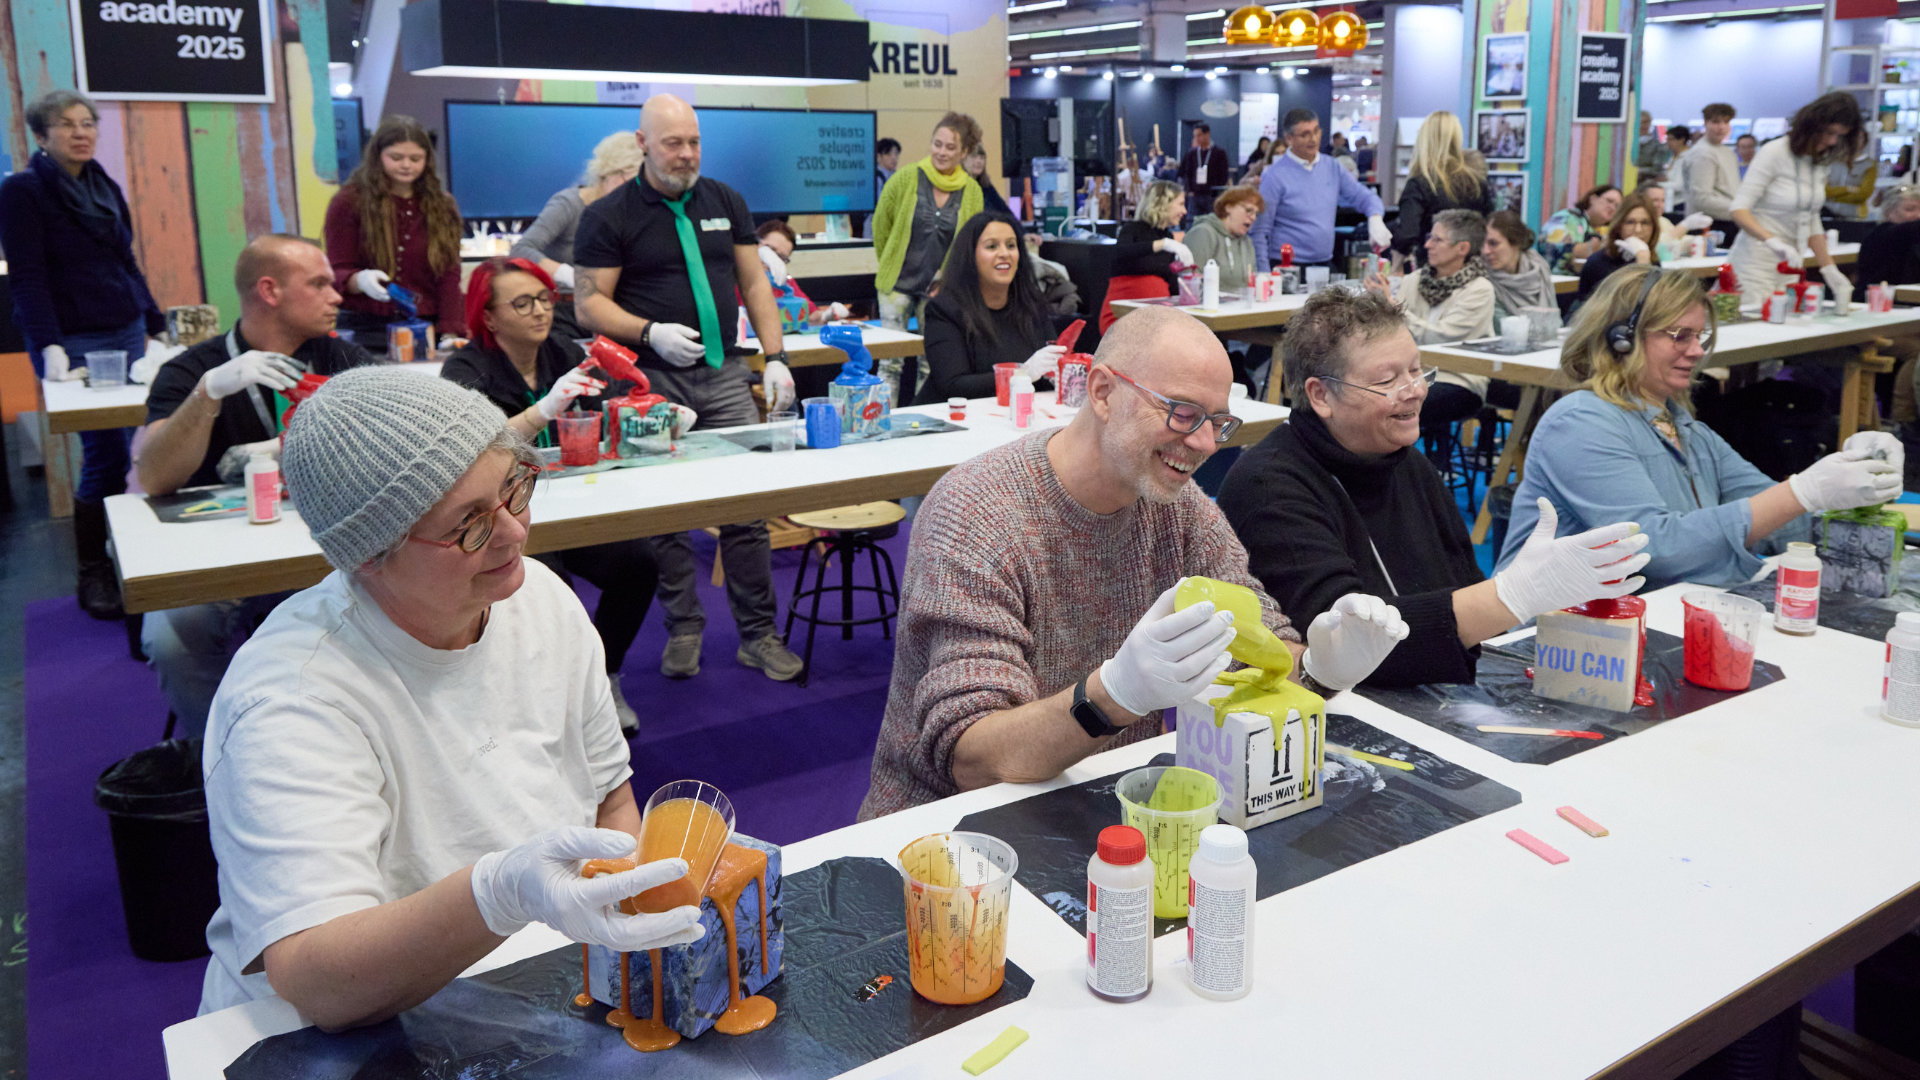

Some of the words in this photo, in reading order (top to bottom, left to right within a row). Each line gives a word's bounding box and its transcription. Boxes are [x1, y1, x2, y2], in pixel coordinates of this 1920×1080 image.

[99, 0, 244, 34] academy
[176, 34, 246, 60] 2025
[1581, 69, 1621, 86] academy
[1536, 643, 1576, 673] YOU
[1581, 652, 1625, 683] CAN
[1182, 709, 1233, 766] YOU
[1251, 791, 1273, 808] THIS
[1275, 786, 1295, 800] WAY
